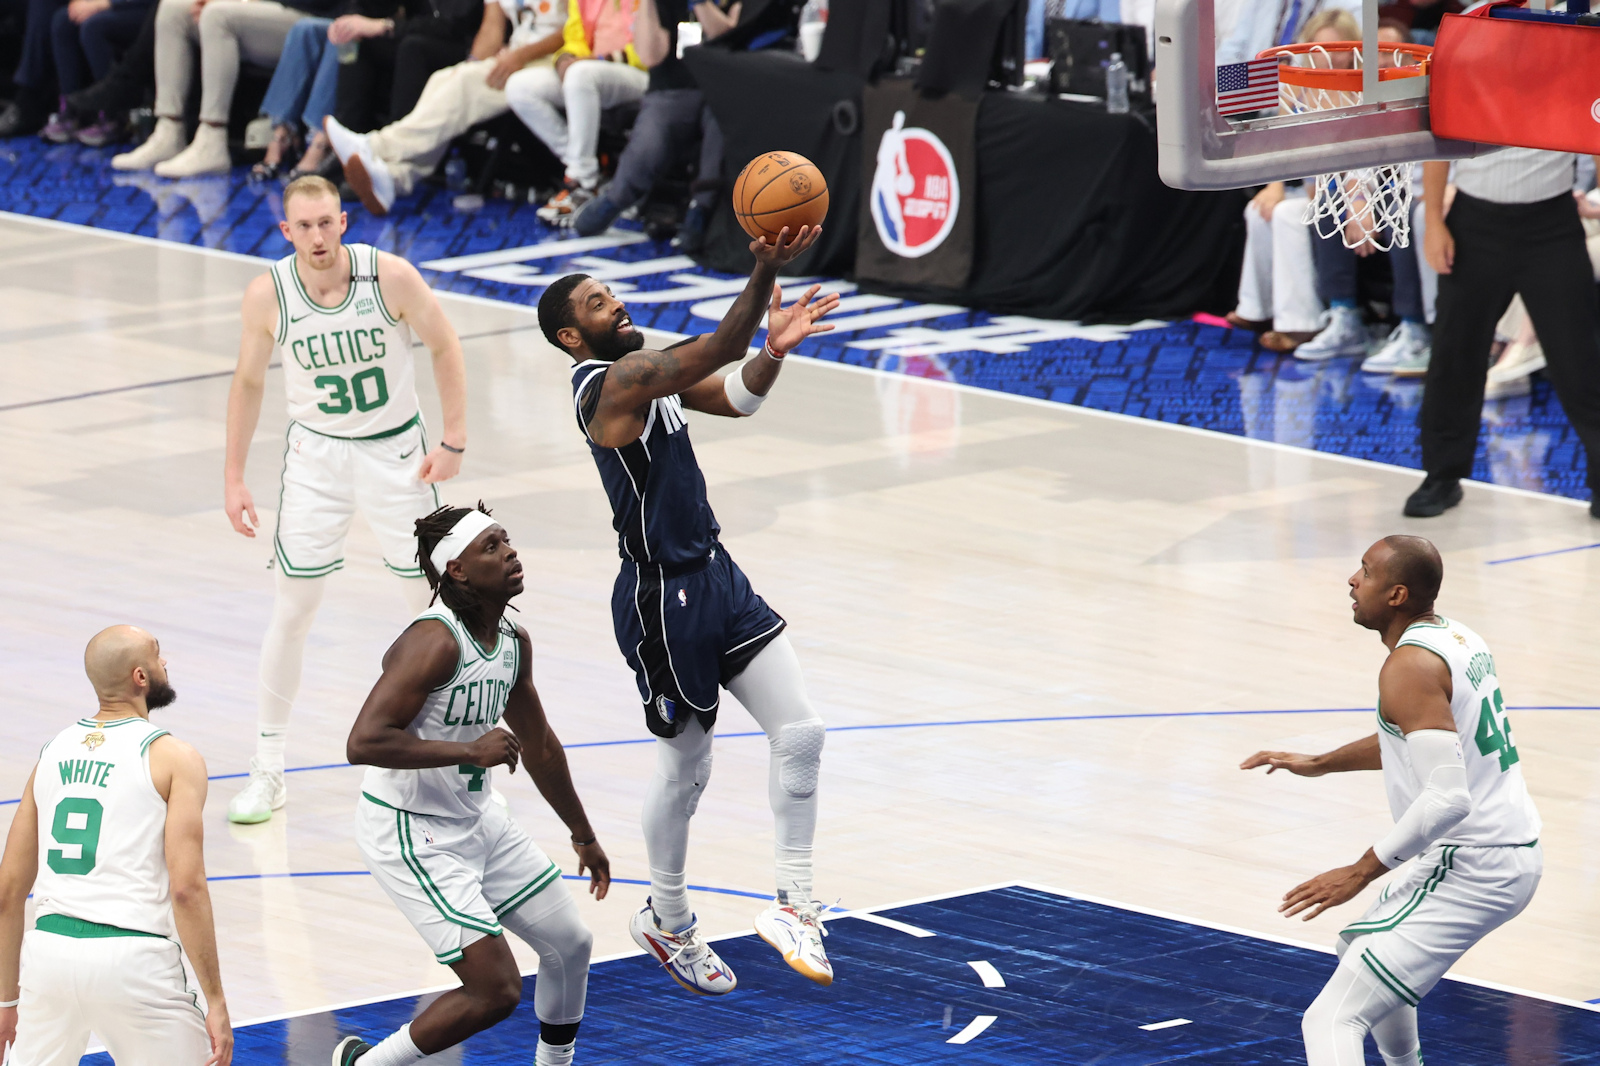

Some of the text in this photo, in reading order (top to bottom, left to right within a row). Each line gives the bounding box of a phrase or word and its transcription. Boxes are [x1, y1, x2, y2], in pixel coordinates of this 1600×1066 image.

[923, 174, 949, 200] NBA
[903, 198, 948, 220] ESPN
[354, 297, 375, 309] VISTA
[357, 306, 376, 317] PRINT
[292, 328, 386, 370] CELTICS
[314, 366, 389, 414] 30
[503, 650, 514, 661] VISTA
[1474, 687, 1520, 773] 42
[58, 759, 115, 788] WHITE
[47, 797, 104, 876] 9
